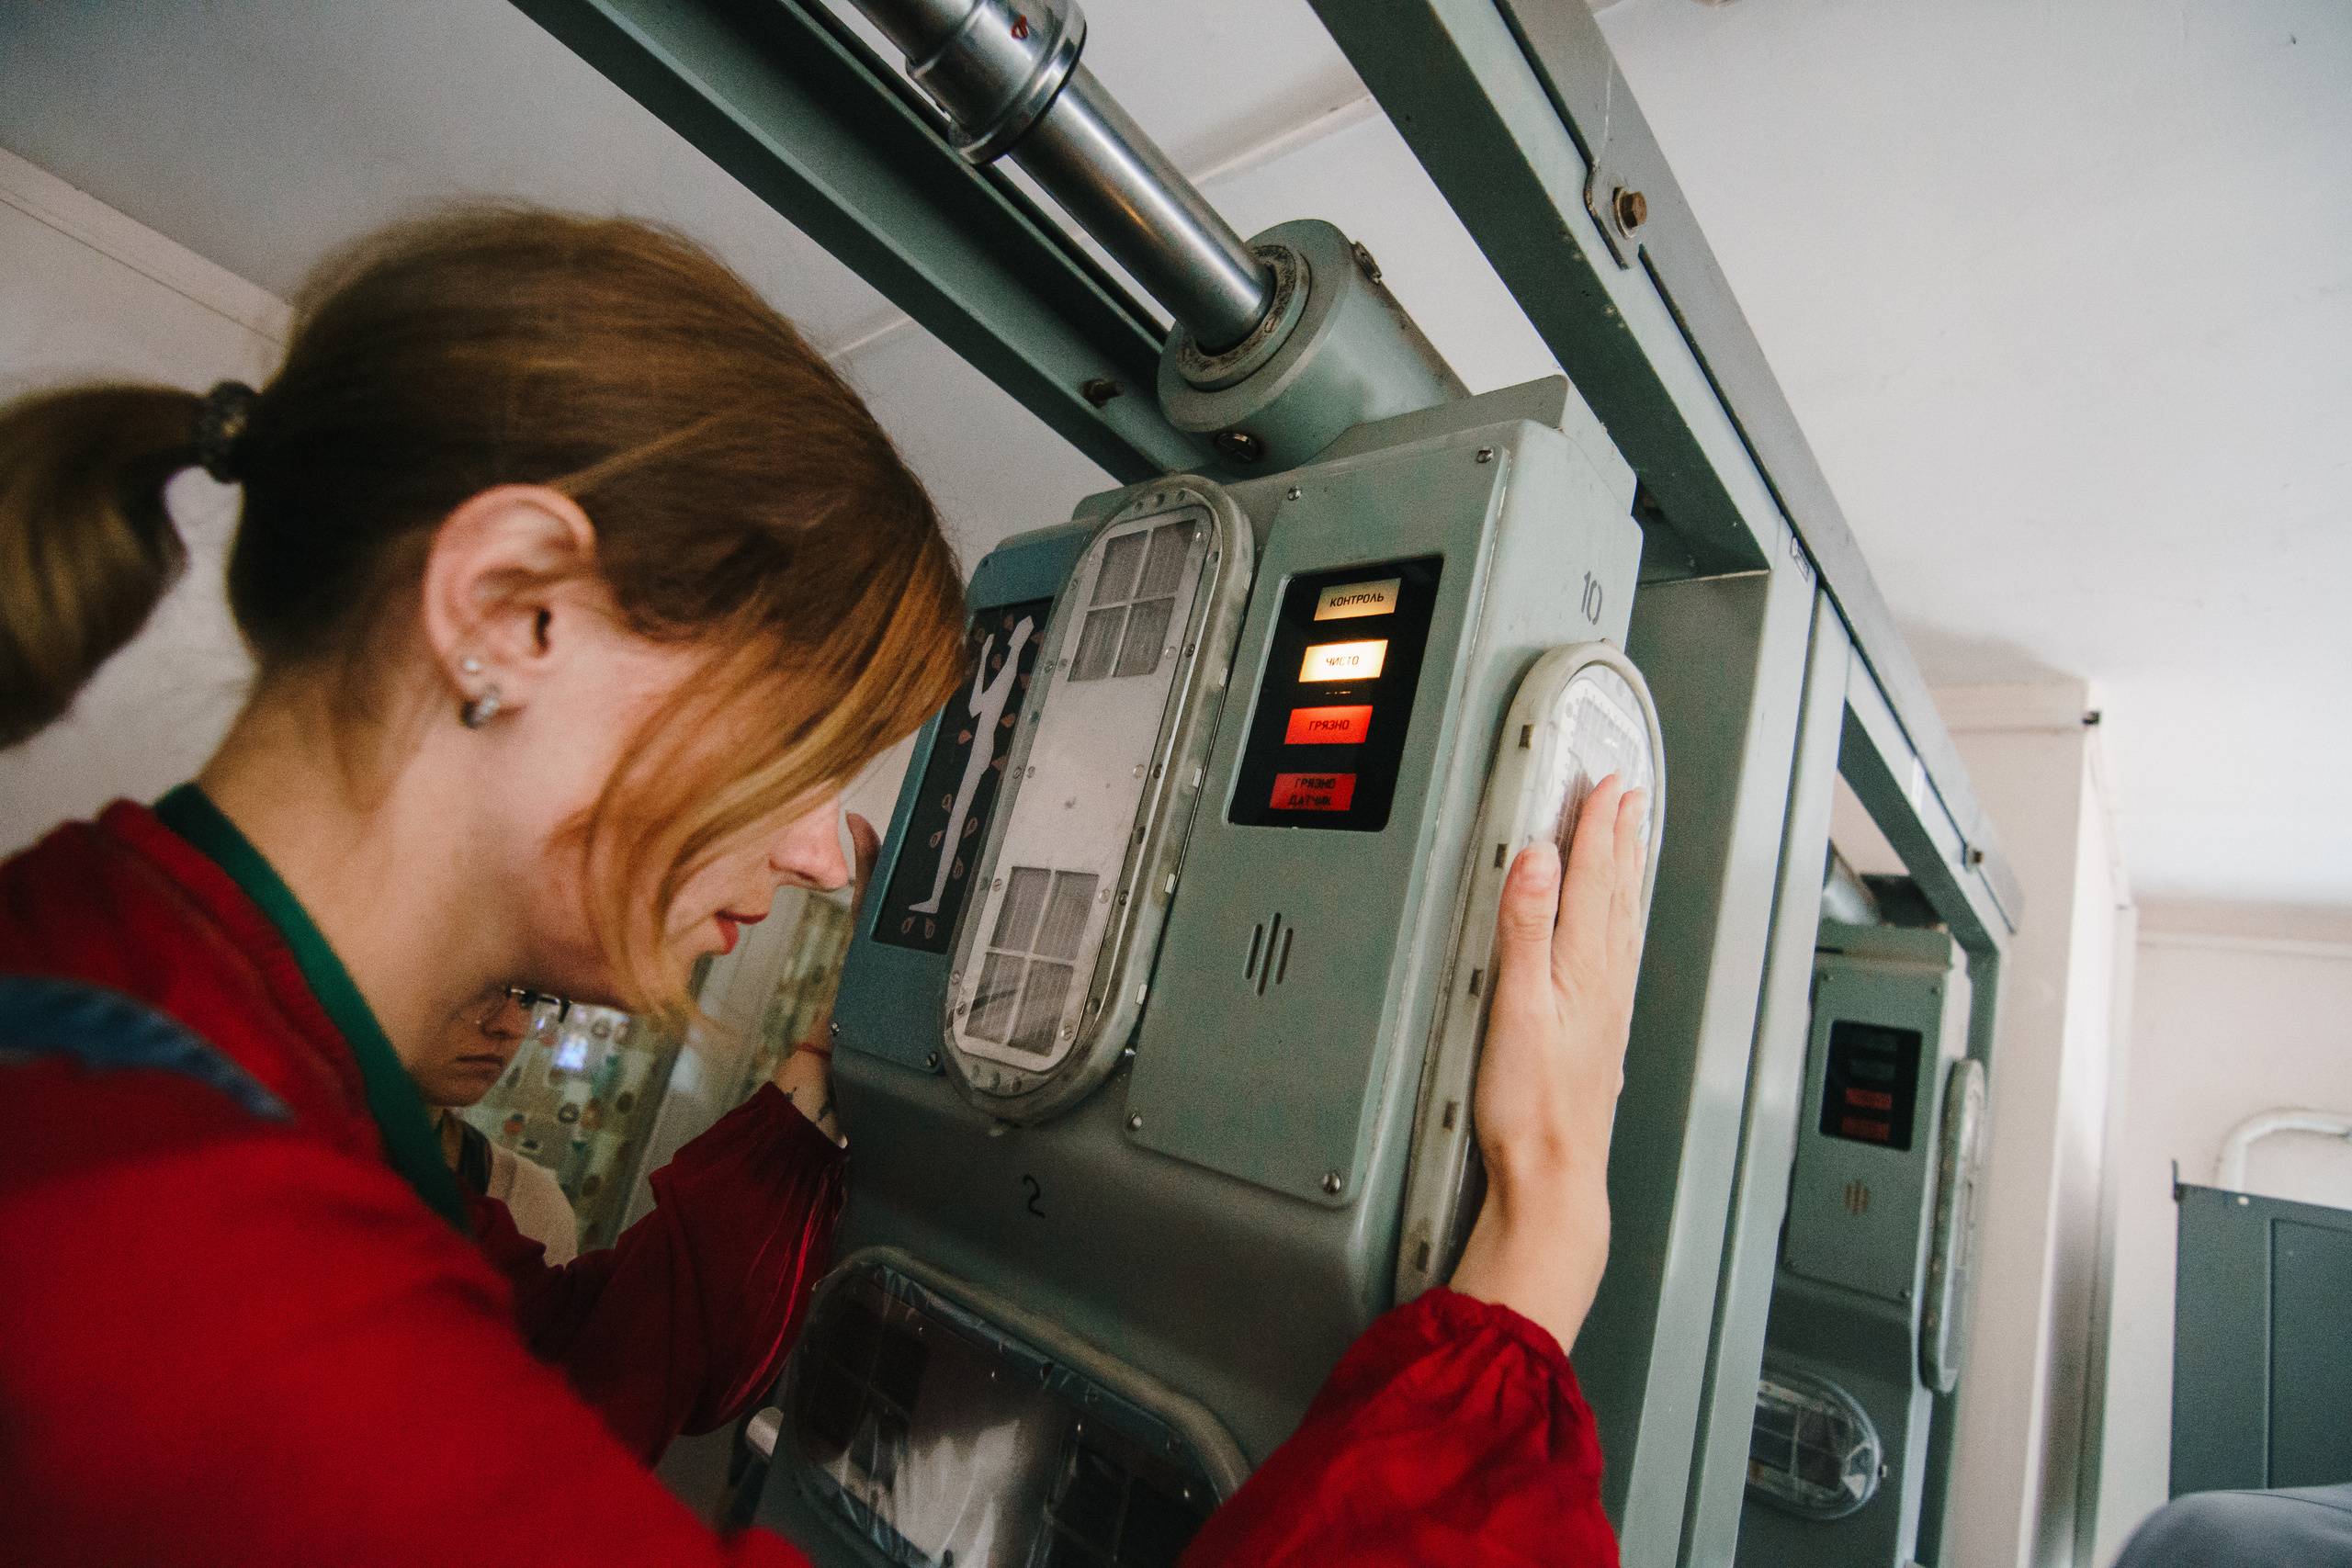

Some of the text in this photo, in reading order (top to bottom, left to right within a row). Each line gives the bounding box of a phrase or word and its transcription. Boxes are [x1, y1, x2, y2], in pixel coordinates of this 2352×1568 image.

[1329, 592, 1385, 608] КОНТРОЛЬ
[1580, 570, 1603, 626] 10
[1325, 655, 1360, 667] ЧИСТО
[1307, 718, 1351, 732] ГРЯЗНО
[1294, 777, 1337, 790] ГРЯЗНО
[1286, 794, 1333, 807] ДАТЧИК
[1022, 1173, 1046, 1219] 2
